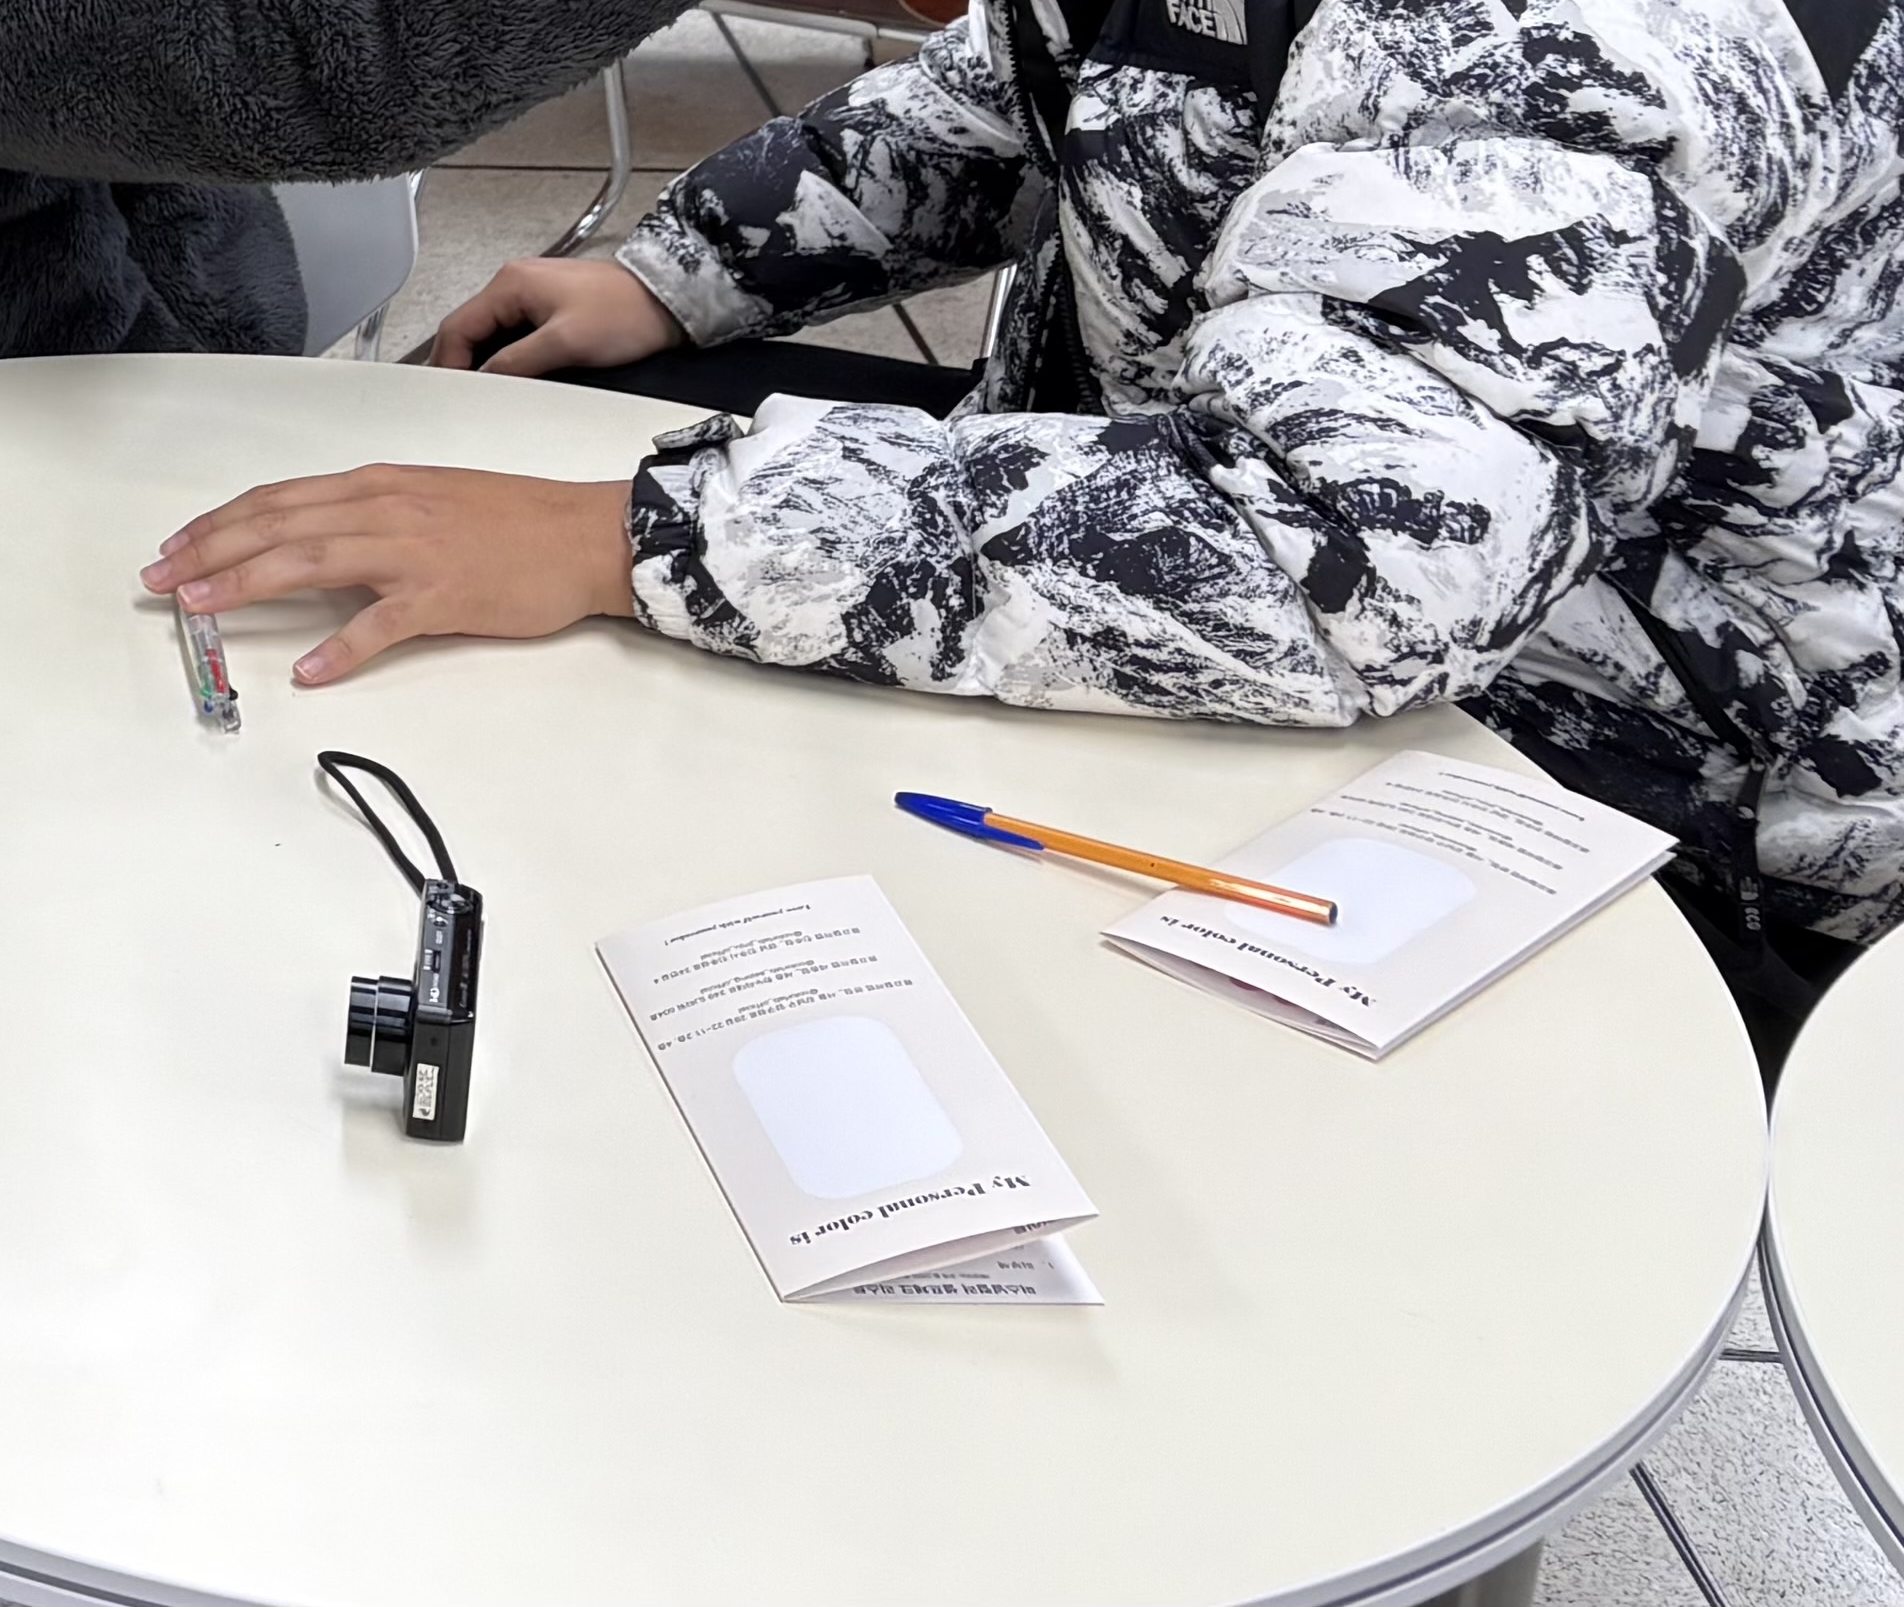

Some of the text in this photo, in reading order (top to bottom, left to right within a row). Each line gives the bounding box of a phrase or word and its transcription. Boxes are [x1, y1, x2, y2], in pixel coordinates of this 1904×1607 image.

[1160, 915, 1377, 1007] My Personal color is
[789, 1175, 1031, 1246] My Personal color is
